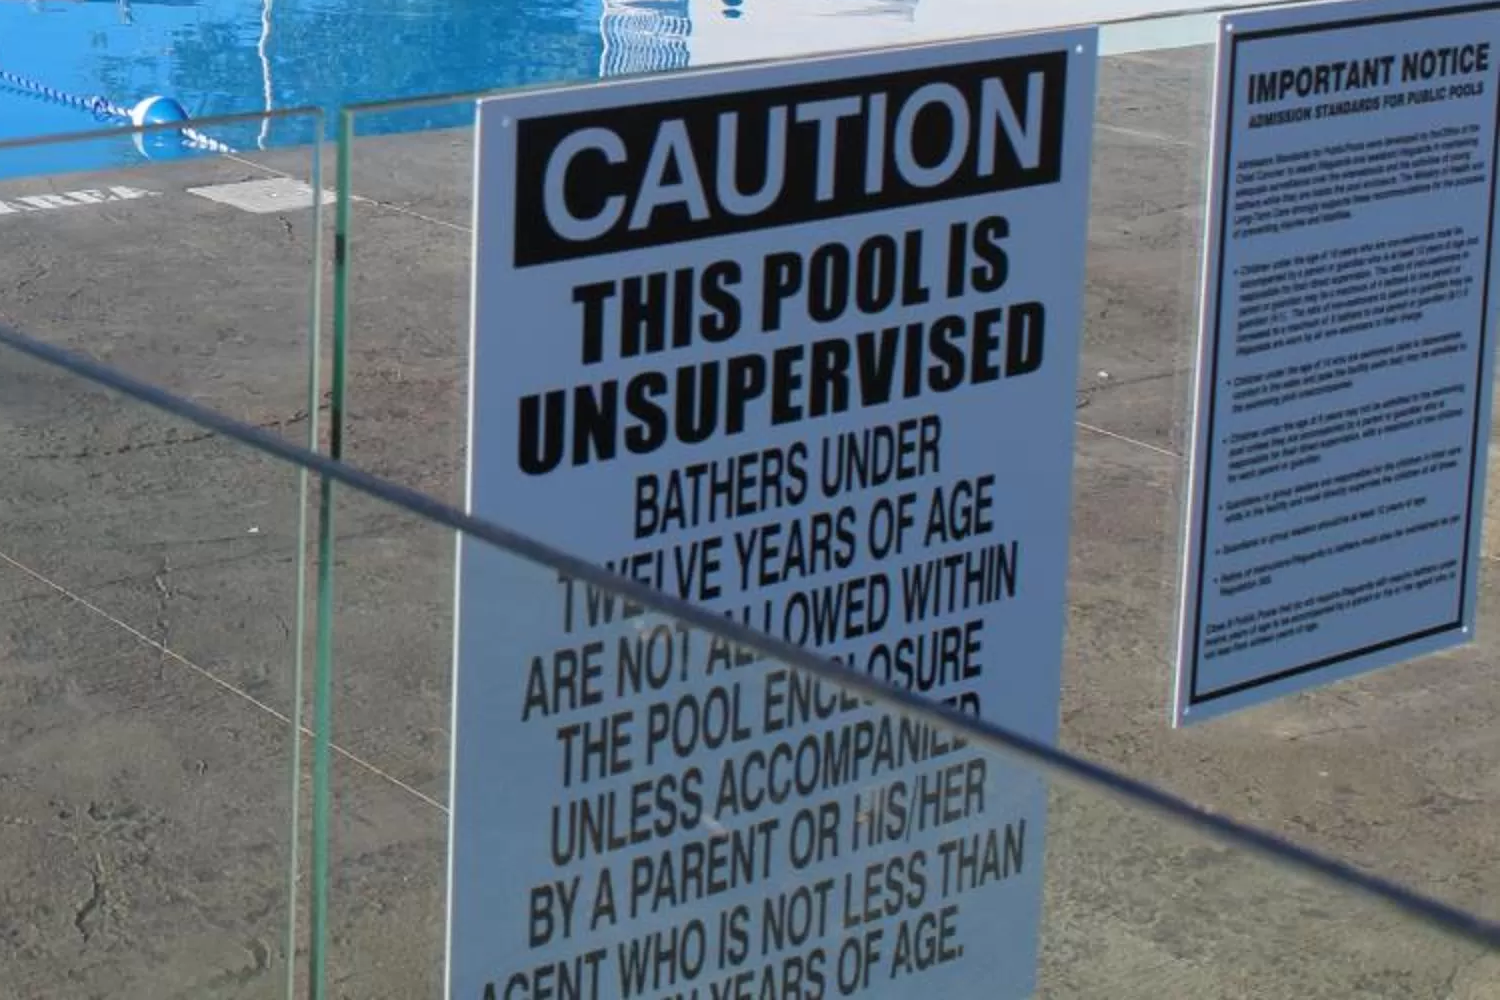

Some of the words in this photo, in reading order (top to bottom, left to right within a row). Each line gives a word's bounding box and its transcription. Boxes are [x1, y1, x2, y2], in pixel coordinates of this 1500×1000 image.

[1248, 55, 1395, 105] IMPORTANT
[1402, 42, 1490, 83] NOTICE
[1248, 107, 1311, 129] ADMISSION
[1315, 96, 1380, 120] STANDARDS
[1383, 93, 1404, 108] FOR
[1407, 87, 1446, 106] PUBLIC
[1449, 81, 1484, 99] POOLS
[542, 72, 1045, 241] CAUTION
[572, 260, 743, 364] THIS
[761, 229, 929, 332] POOL
[947, 215, 1010, 298] IS
[517, 301, 1045, 476] UNSUPERVISED
[557, 536, 723, 634] TWELVE
[734, 507, 856, 591] YEARS
[868, 502, 915, 560] OF
[923, 475, 995, 547] AGE
[634, 441, 808, 538] BATHERS
[820, 415, 941, 498] UNDER
[522, 641, 604, 722] ARE
[617, 620, 692, 697] NOT
[706, 573, 891, 676] ALLOWED
[902, 540, 1019, 624] WITHIN
[557, 711, 633, 788] THE
[646, 681, 751, 766] POOL
[764, 618, 984, 734] ENCLOSURE
[529, 876, 581, 949] BY
[590, 867, 617, 931] A
[630, 817, 781, 920] PARENT
[789, 808, 842, 870] OR
[851, 757, 988, 843] HIS/HER
[551, 772, 707, 867] UNLESS
[618, 926, 706, 1000] WHO
[718, 904, 751, 970] IS
[762, 878, 835, 956] NOT
[843, 851, 928, 929] LESS
[938, 819, 1026, 898] THAN
[837, 929, 884, 997] OF
[889, 904, 965, 980] AGE.
